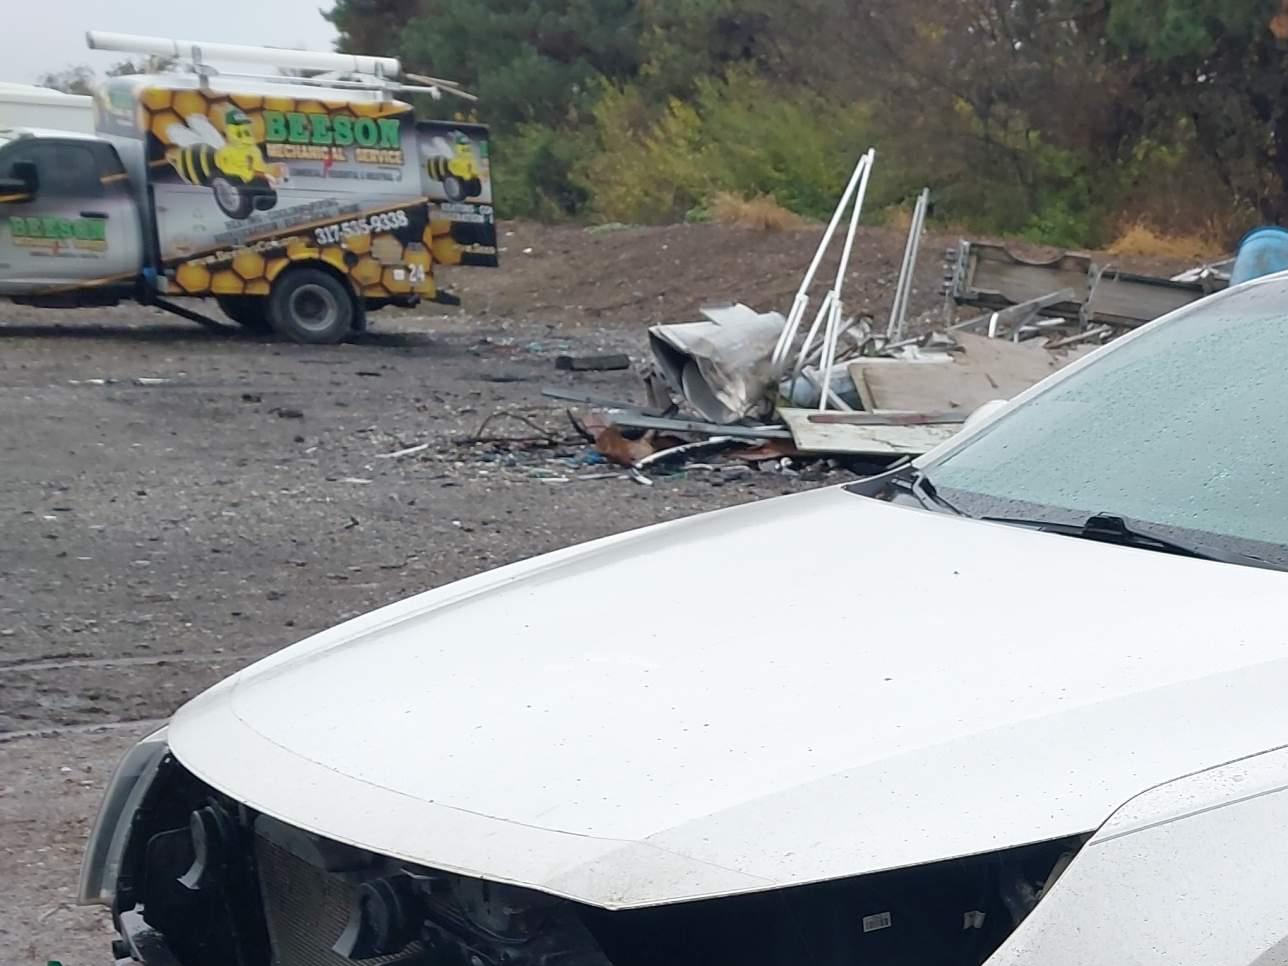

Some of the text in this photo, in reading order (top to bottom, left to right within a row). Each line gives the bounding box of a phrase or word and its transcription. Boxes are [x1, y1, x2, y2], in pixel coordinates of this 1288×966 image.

[264, 110, 401, 149] BEESON
[314, 209, 410, 245] 317-535-9338
[408, 263, 425, 282] 24
